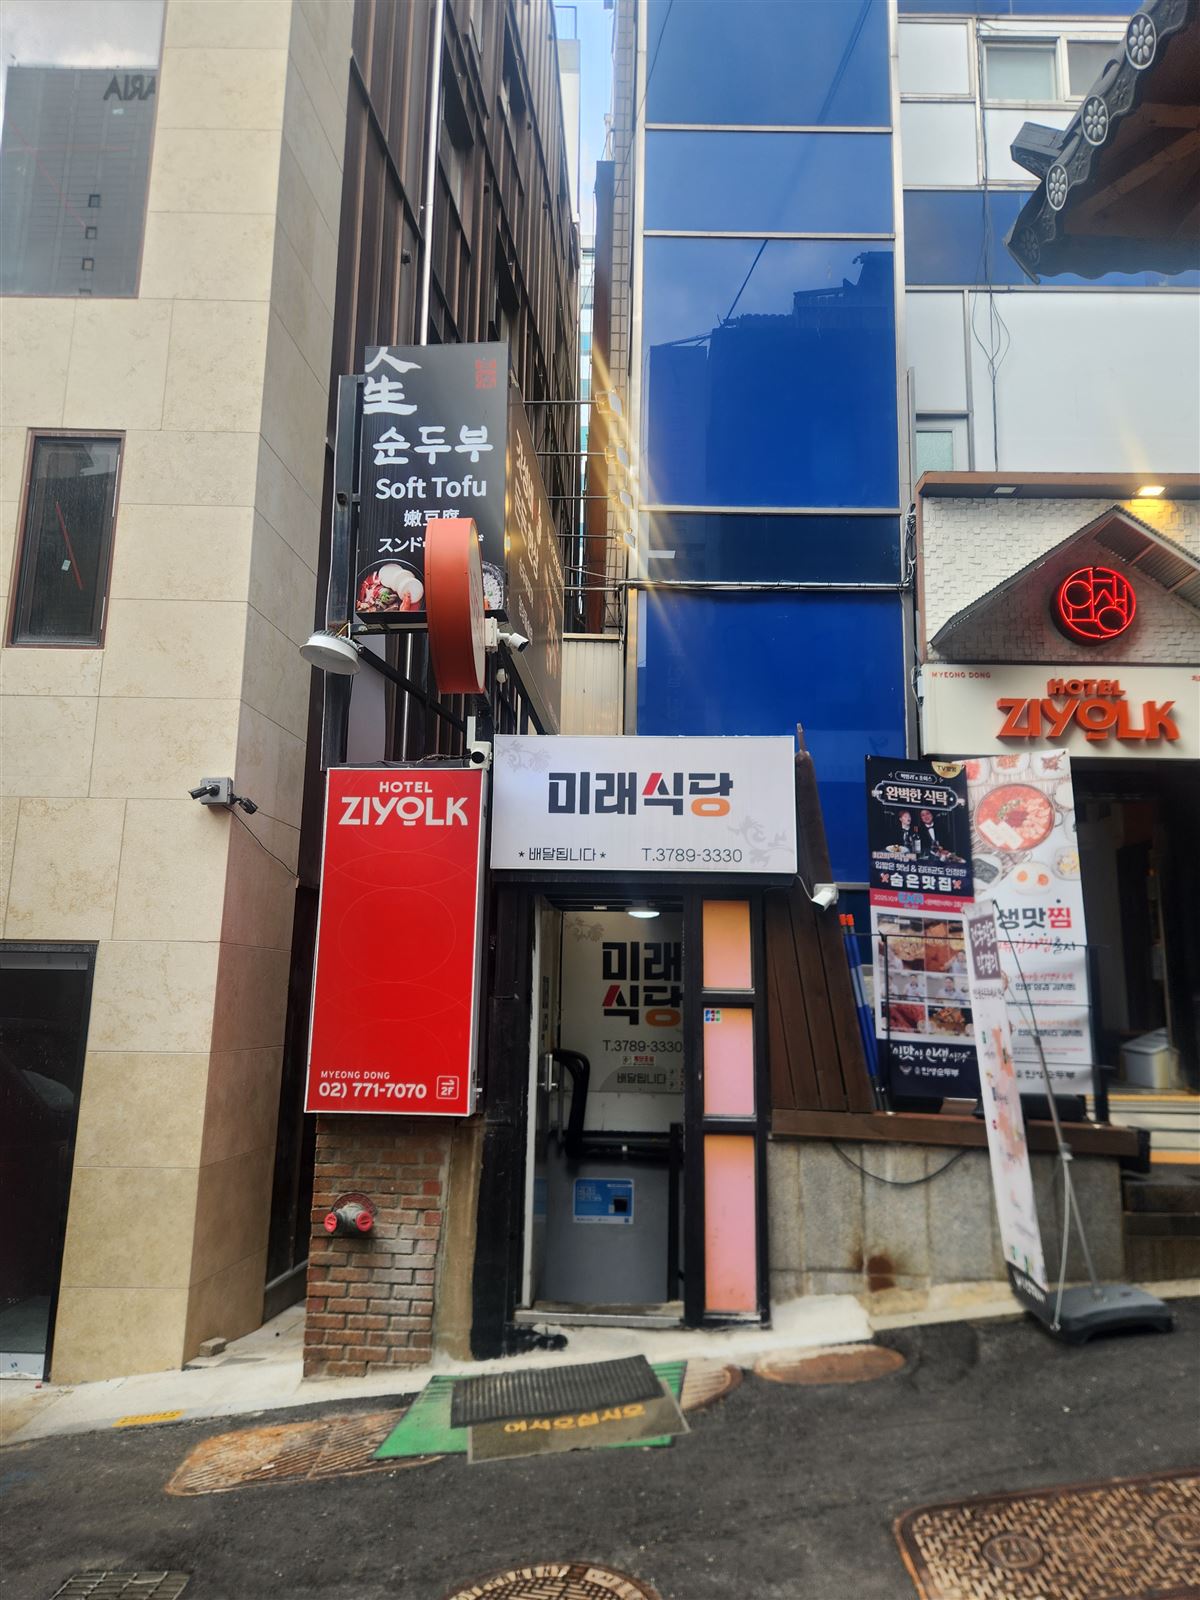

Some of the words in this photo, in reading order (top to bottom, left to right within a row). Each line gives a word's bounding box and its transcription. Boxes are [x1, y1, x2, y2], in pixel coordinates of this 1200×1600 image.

[362, 346, 422, 416] 人生
[372, 425, 494, 466] 순두부
[375, 476, 426, 499] Soft
[431, 474, 487, 498] Tofu
[931, 671, 966, 679] MYEONG
[1047, 678, 1126, 697] HOTEL
[996, 697, 1180, 741] ZIYOLK
[379, 782, 432, 793] HOTEL
[547, 772, 734, 817] 미래식당
[885, 785, 922, 803] 완벽한
[923, 790, 948, 806] 식탁
[338, 796, 469, 826] ZIYOLK
[528, 847, 596, 862] 배달됩니다
[641, 847, 743, 863] T.3789-3330
[602, 941, 682, 981] 미래
[602, 984, 683, 1027] 식당
[603, 1040, 682, 1052] T.3789-3330
[321, 1071, 361, 1080] MYEONG
[364, 1071, 390, 1080] DONG
[319, 1082, 348, 1099] 02)
[352, 1083, 428, 1099] 771-7070
[440, 1086, 454, 1096] 2F
